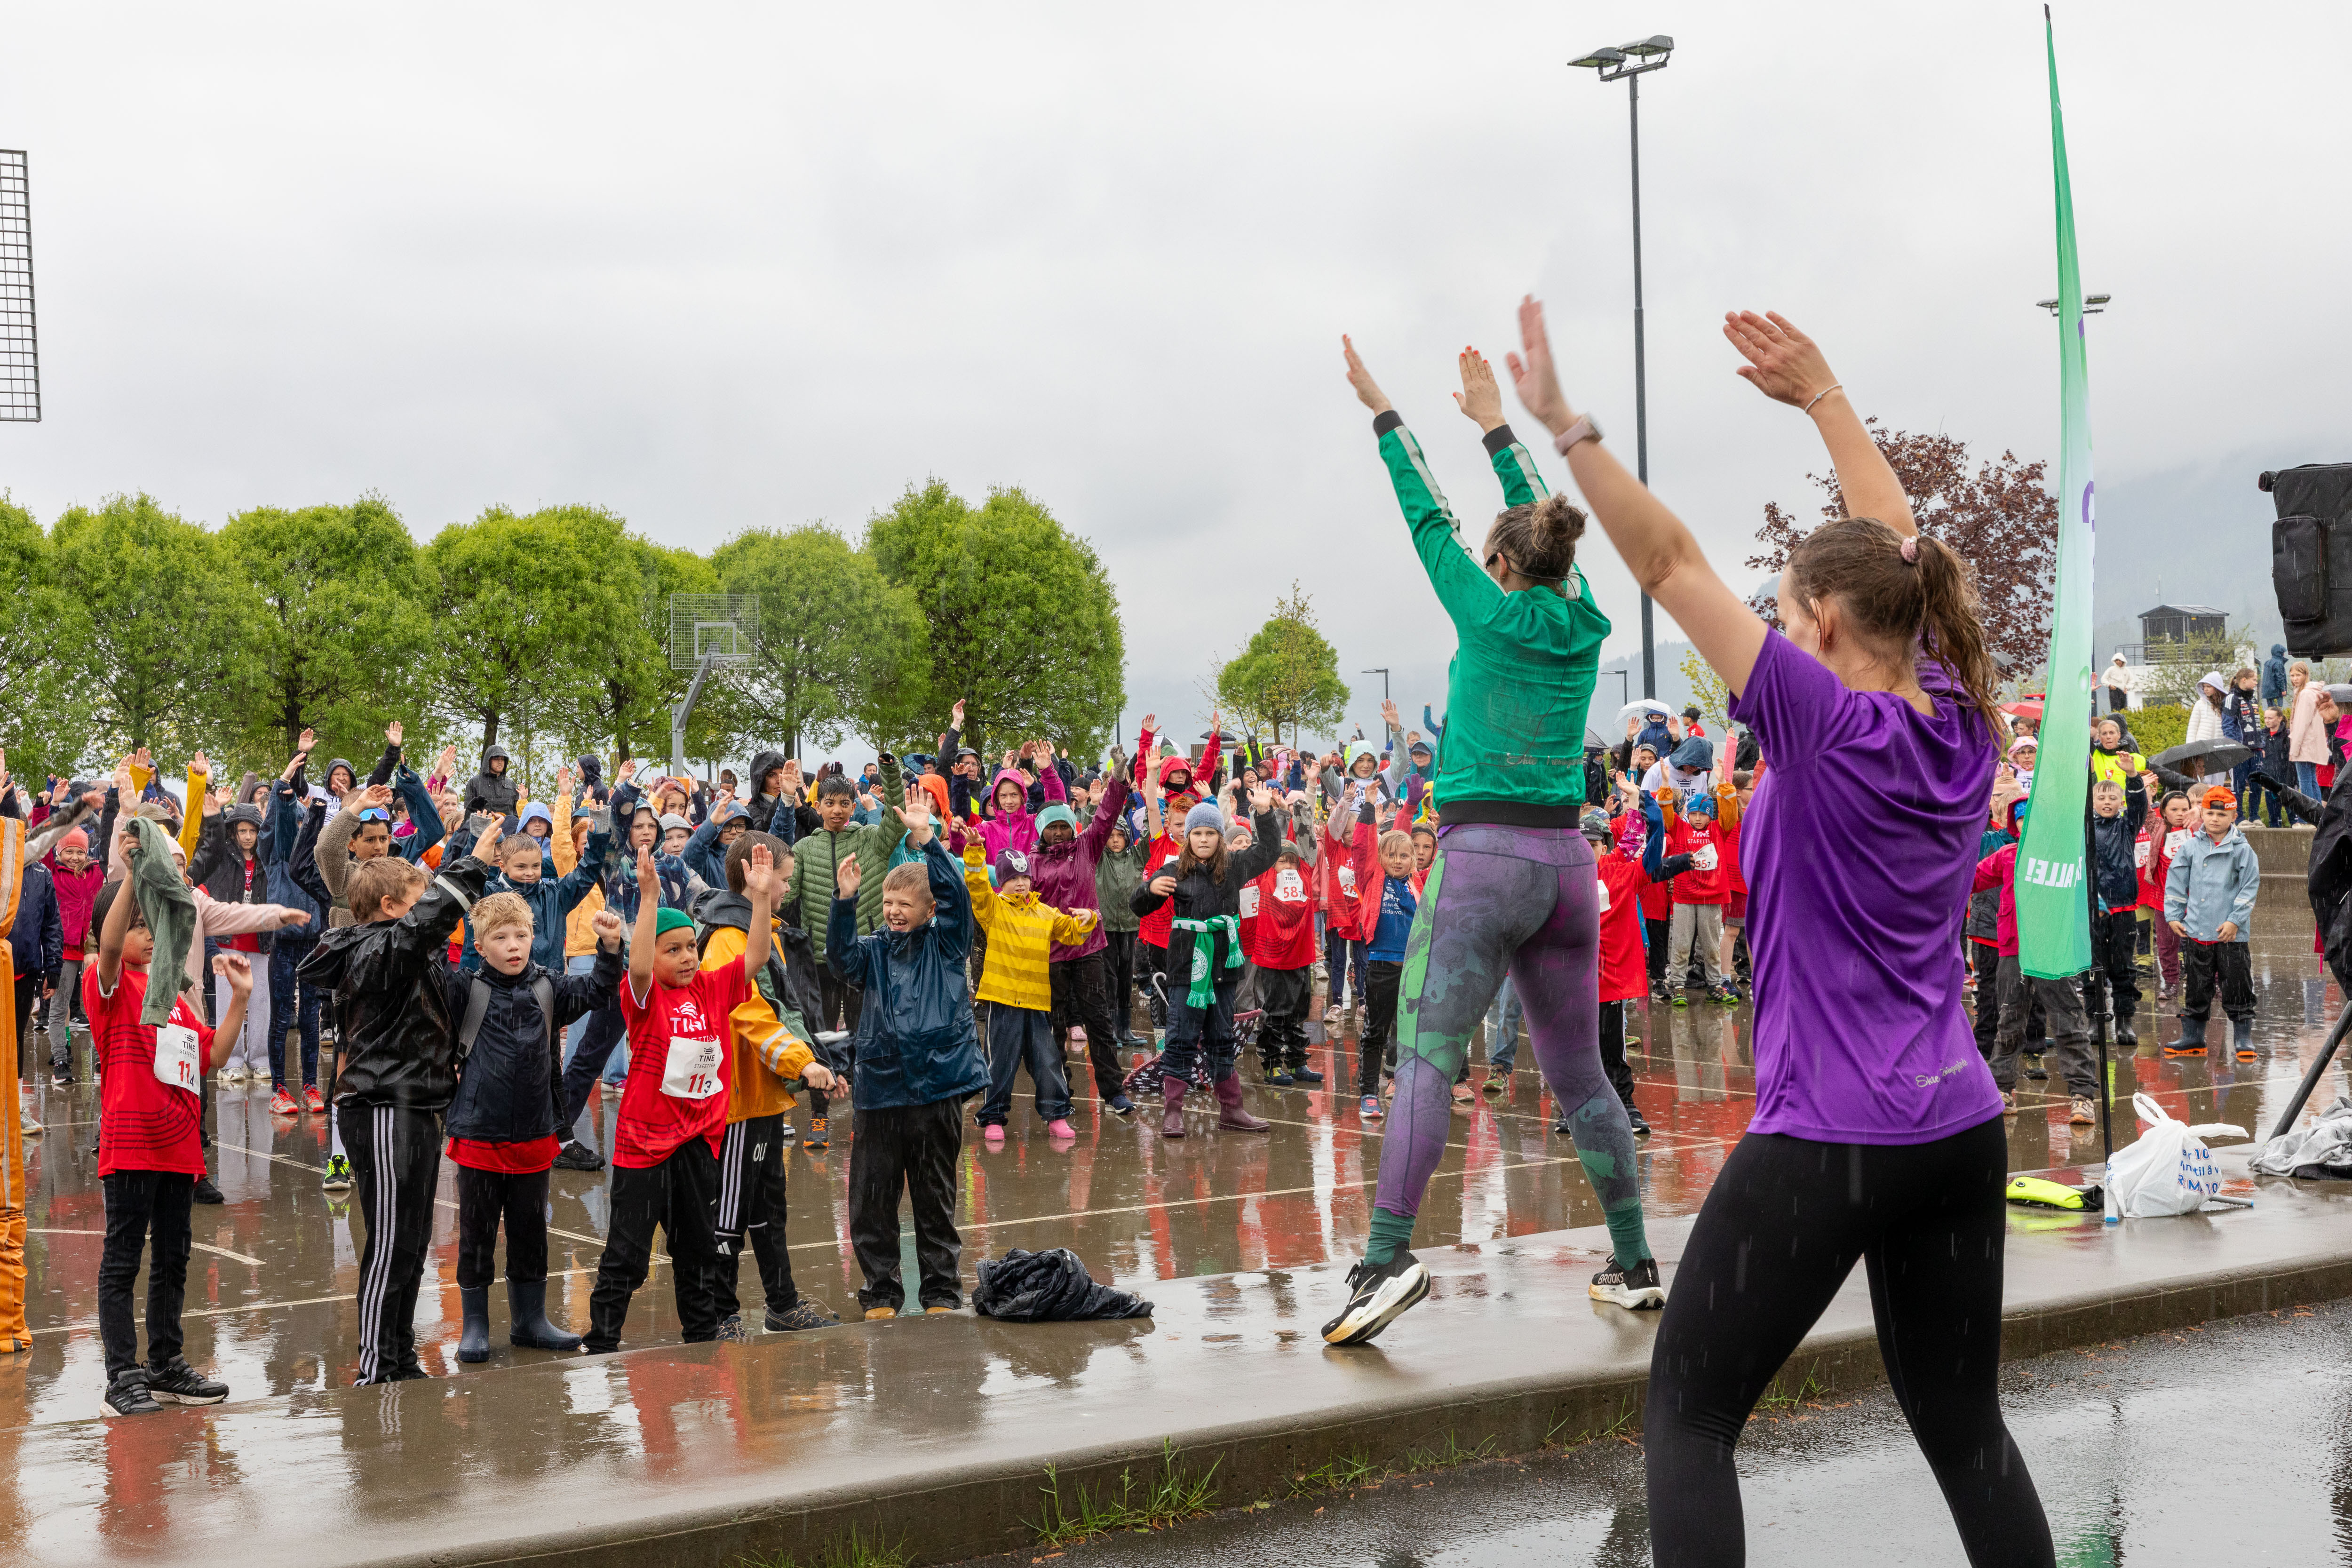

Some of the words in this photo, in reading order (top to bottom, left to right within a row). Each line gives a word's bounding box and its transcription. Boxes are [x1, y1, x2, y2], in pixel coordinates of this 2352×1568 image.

[1283, 886, 1302, 899] 587
[182, 1041, 196, 1053] TINE
[1597, 1272, 1624, 1284] BROOKS
